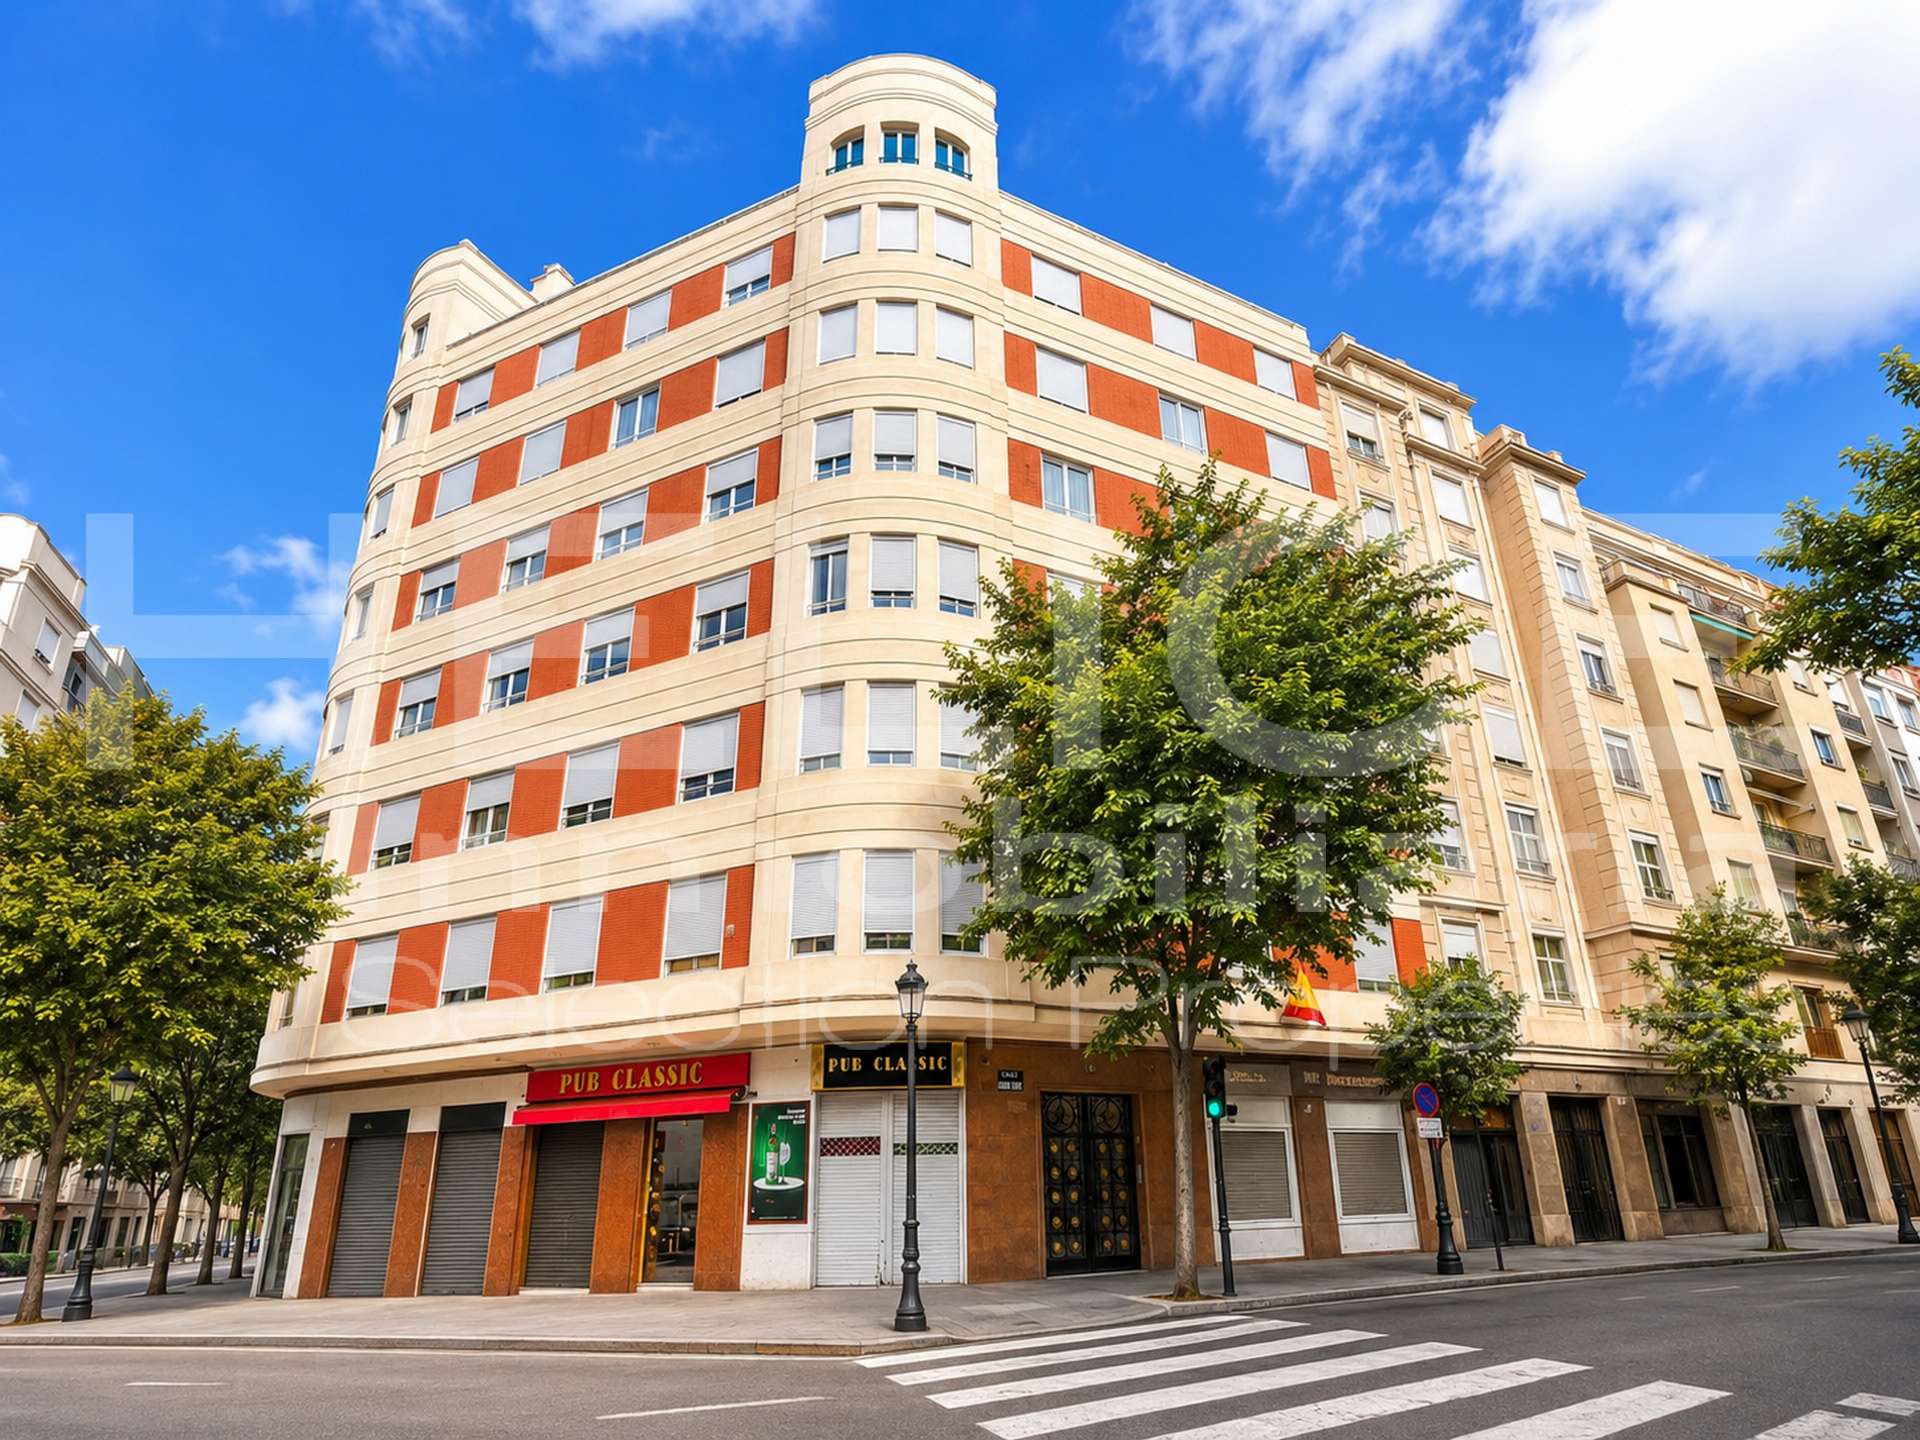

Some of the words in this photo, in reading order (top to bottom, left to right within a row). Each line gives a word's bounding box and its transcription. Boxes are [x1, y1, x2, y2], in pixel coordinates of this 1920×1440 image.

[828, 1057, 862, 1072] PUB
[873, 1056, 947, 1072] CLASIC
[559, 1071, 600, 1094] PUB
[612, 1062, 703, 1091] CLASSIC
